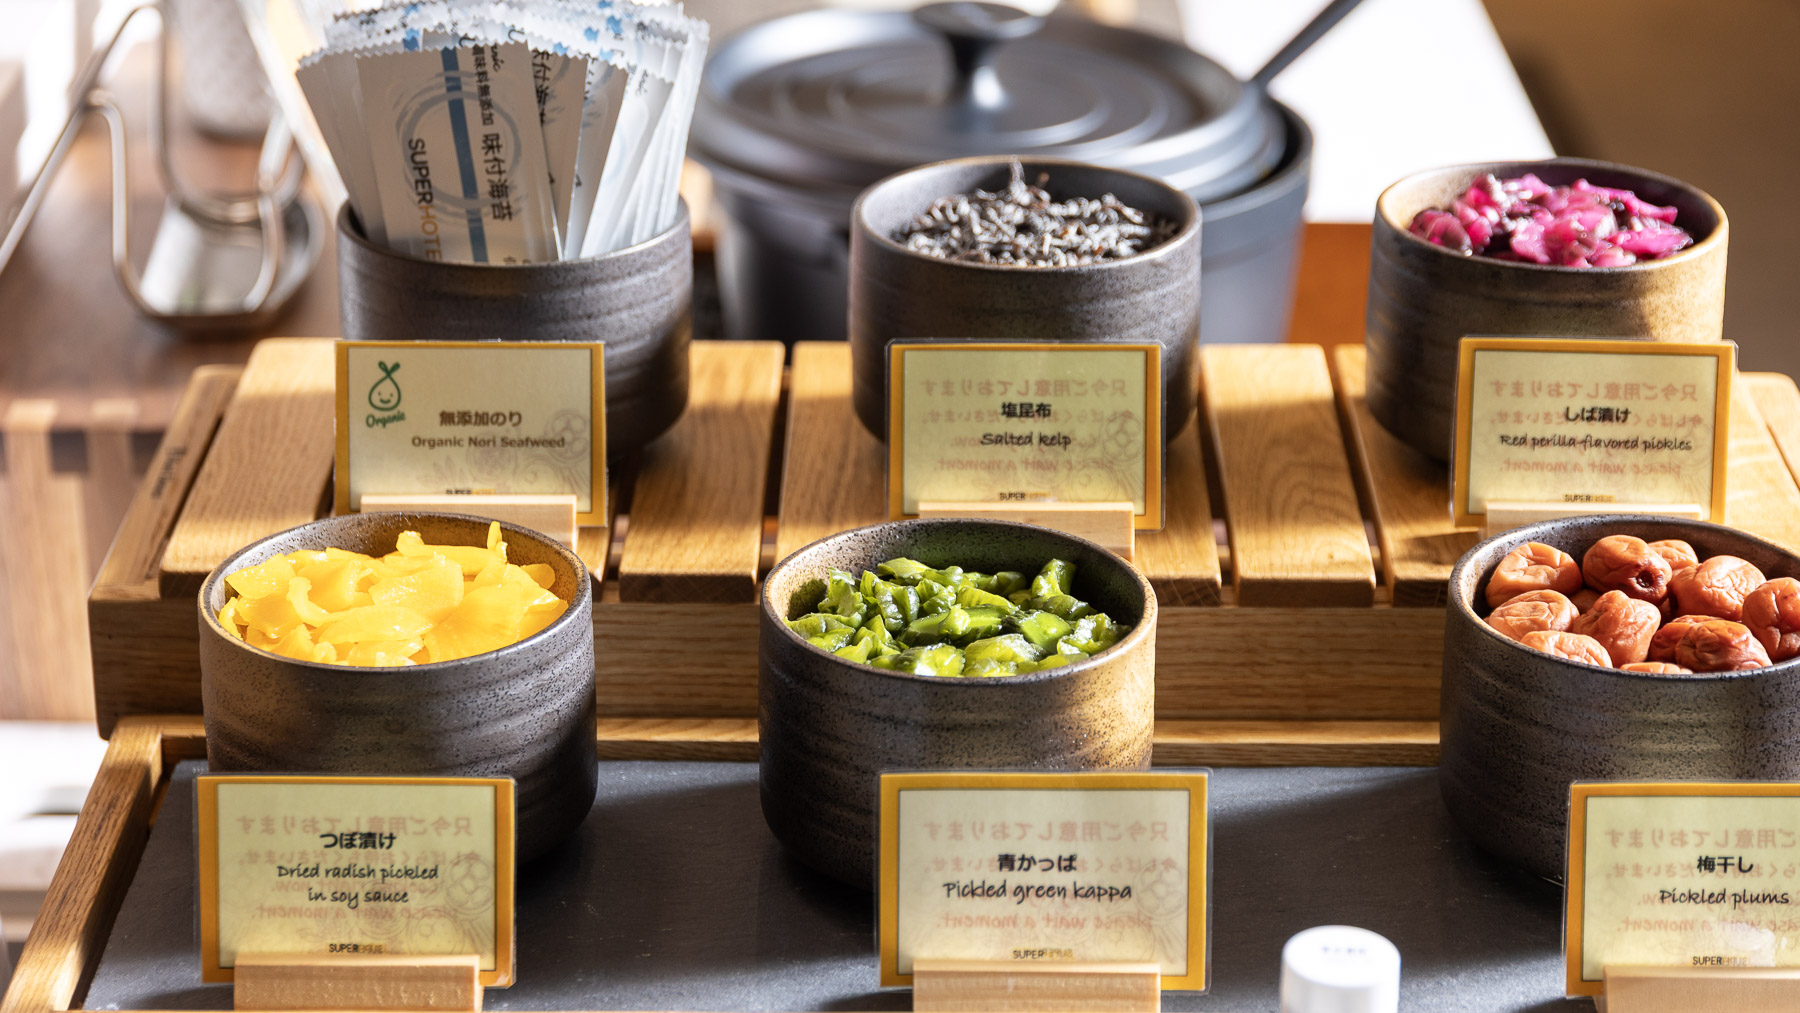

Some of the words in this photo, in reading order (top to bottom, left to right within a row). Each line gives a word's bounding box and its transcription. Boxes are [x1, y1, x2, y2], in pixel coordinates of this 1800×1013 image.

[481, 132, 514, 221] 味付海苔
[439, 410, 523, 427] 無添加のり
[1001, 402, 1052, 418] 塩昆布
[1564, 406, 1632, 423] しば漬け
[365, 410, 406, 429] Organic
[411, 435, 464, 450] Organic
[468, 435, 496, 448] Nori
[500, 435, 565, 449] Seafweed
[980, 432, 1033, 446] Salted
[1039, 432, 1072, 450] kelp
[1500, 434, 1527, 447] Red
[1642, 436, 1693, 453] pickles
[319, 832, 397, 850] つぼ漬け
[997, 854, 1078, 872] 青かっぱ
[1697, 855, 1754, 873] 梅干し
[277, 863, 320, 879] Dried
[325, 863, 376, 879] radish
[380, 865, 439, 884] pickled
[308, 887, 327, 902] in
[330, 890, 359, 909] soy
[364, 890, 409, 903] sauce
[942, 880, 1007, 899] Pickled
[1013, 885, 1067, 904] green
[1073, 880, 1132, 902] kappa
[1660, 888, 1726, 904] Pickled
[1732, 888, 1789, 910] plums
